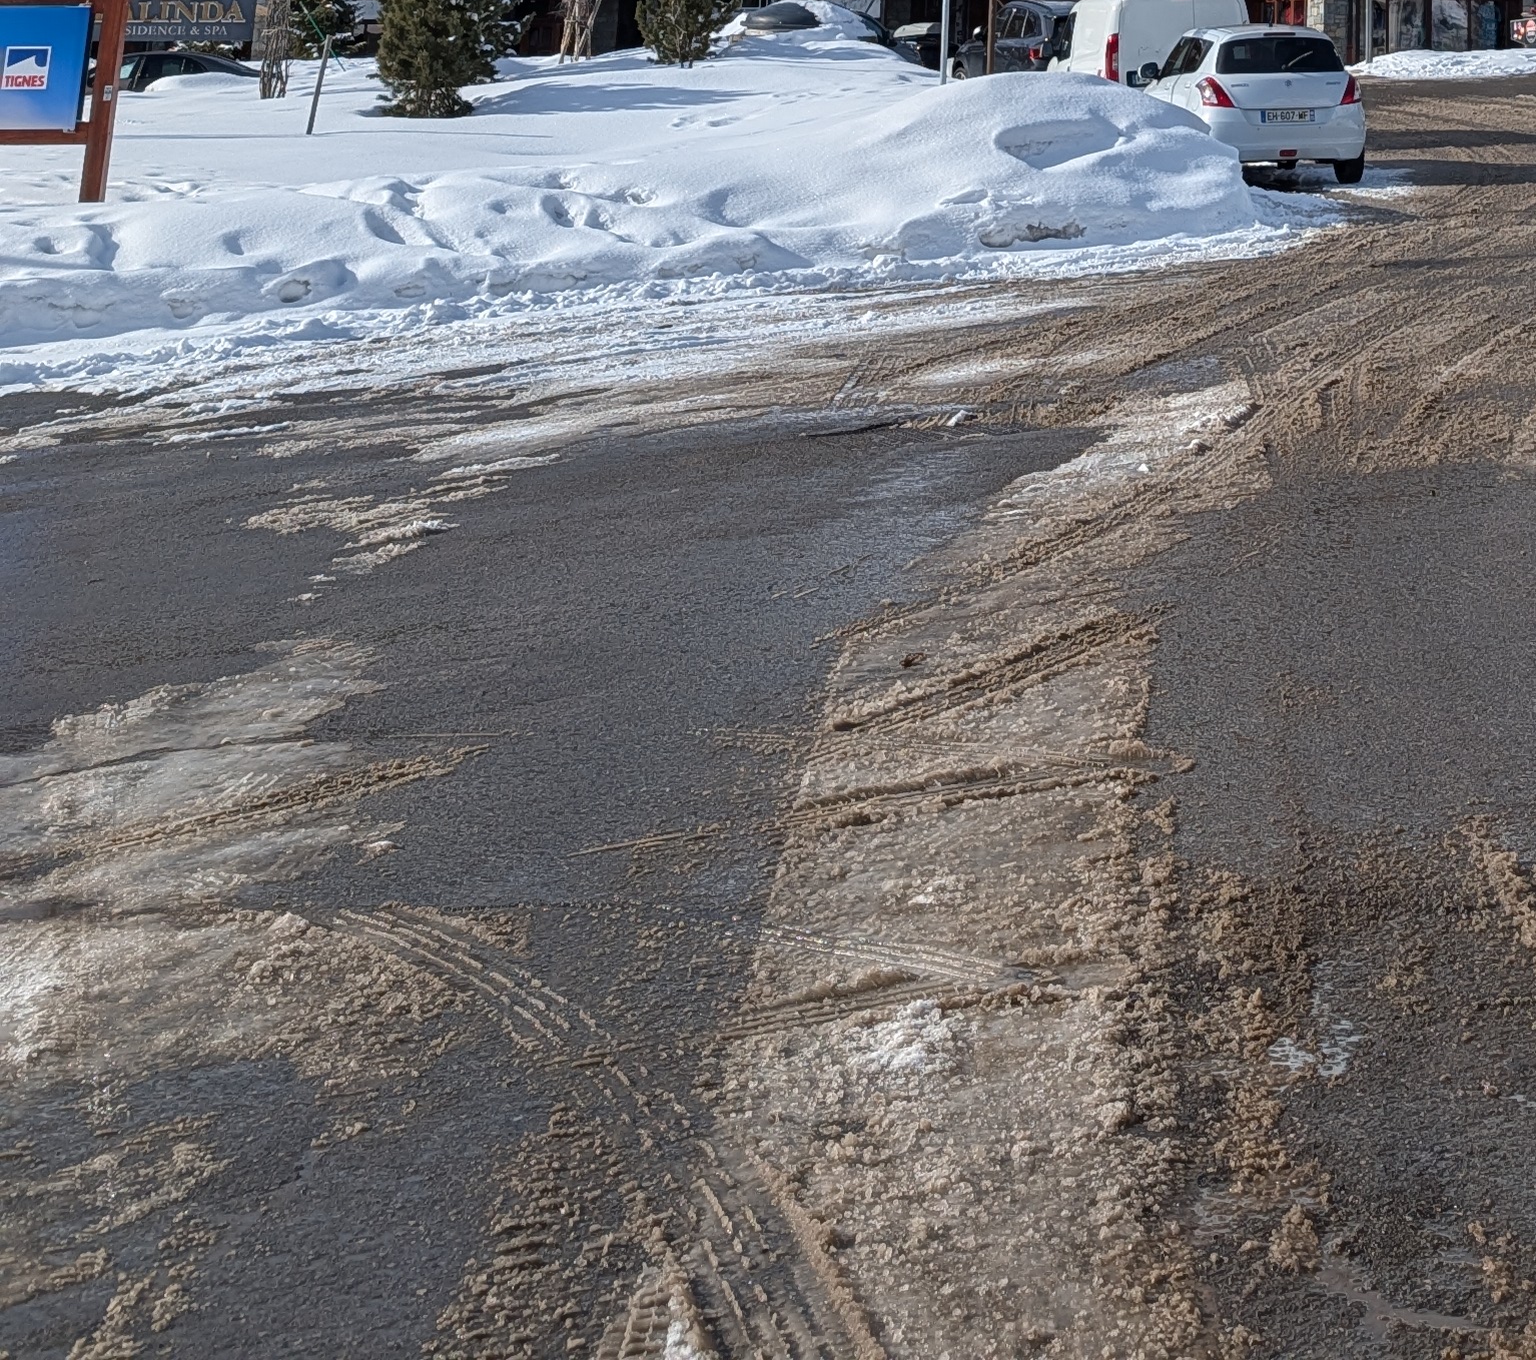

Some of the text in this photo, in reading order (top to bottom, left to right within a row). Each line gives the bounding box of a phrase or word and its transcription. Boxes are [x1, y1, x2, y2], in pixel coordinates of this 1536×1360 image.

[125, 24, 228, 36] SIDENCE & SPA
[4, 74, 46, 88] TIGNES
